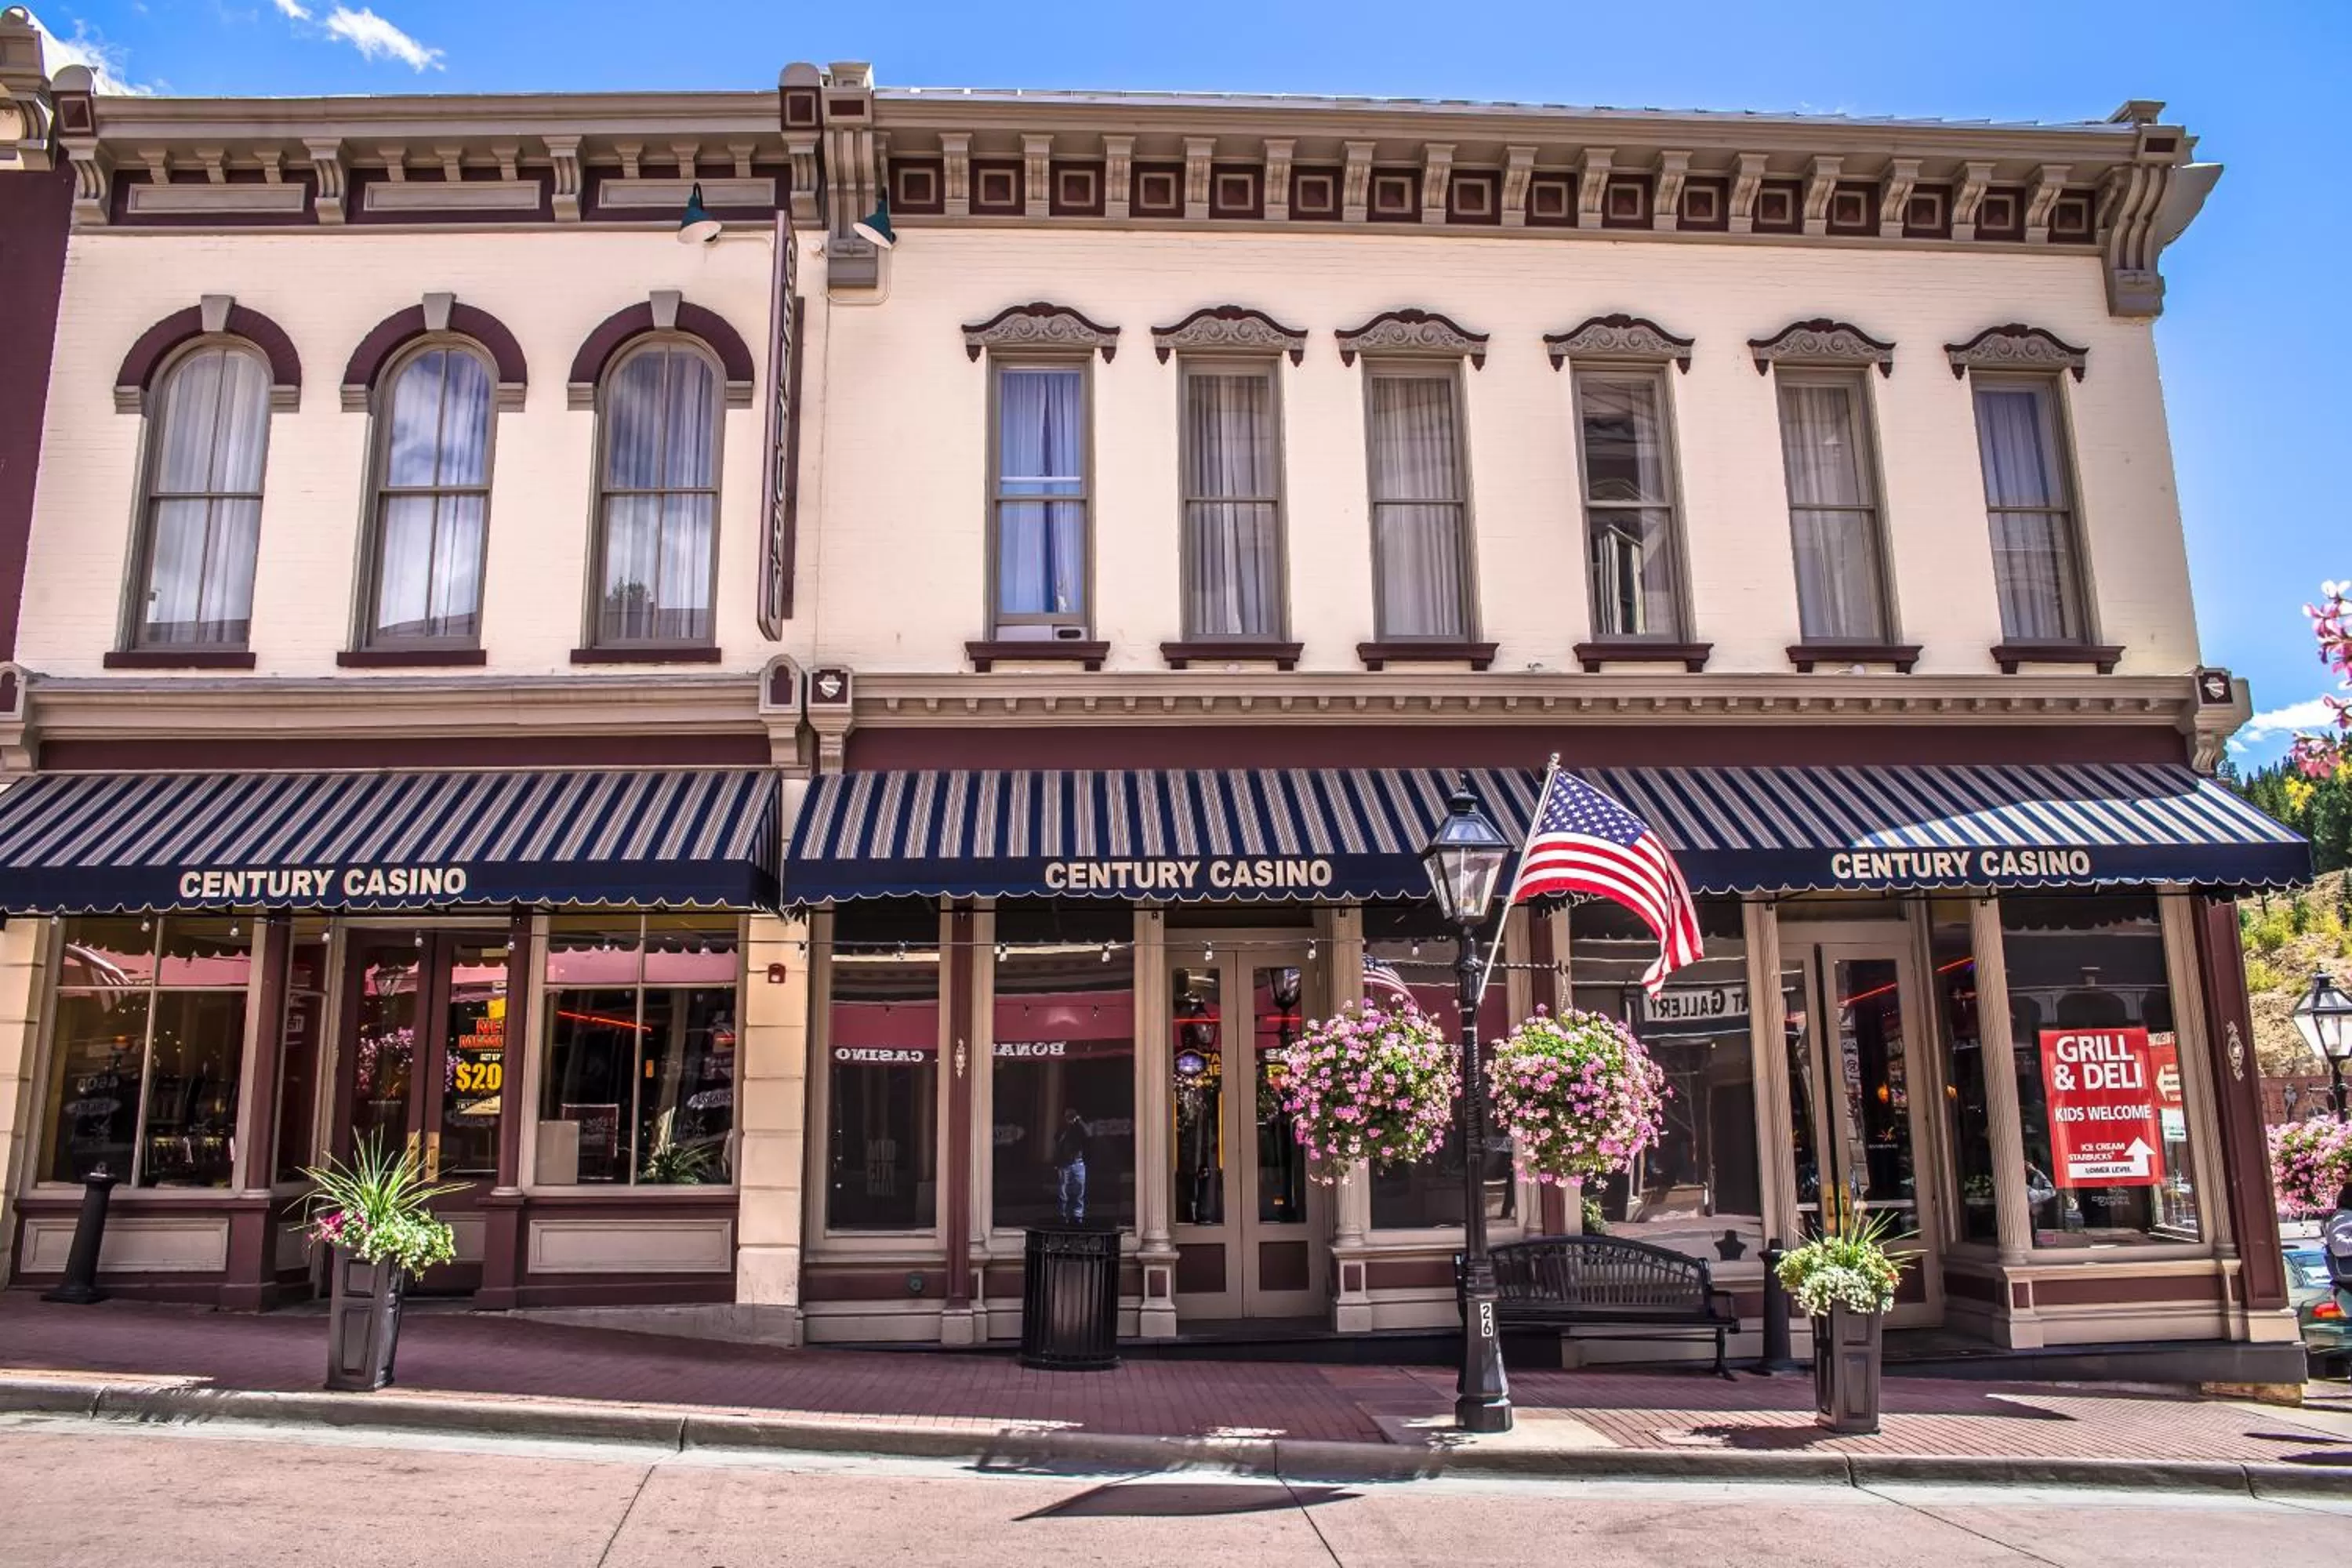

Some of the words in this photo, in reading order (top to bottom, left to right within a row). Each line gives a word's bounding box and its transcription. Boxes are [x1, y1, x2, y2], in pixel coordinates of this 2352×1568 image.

[771, 238, 796, 620] CENTURY
[1045, 862, 1200, 888] CENTURY
[1210, 859, 1332, 887] CASINO
[1831, 851, 1971, 879] CENTURY
[1980, 850, 2090, 877] CASINO
[179, 869, 335, 898] CENTURY
[343, 867, 466, 896] CASINO
[476, 1020, 504, 1035] NE
[2056, 1034, 2135, 1062] GRILL
[2053, 1063, 2076, 1091] &
[2082, 1062, 2143, 1091] DELI
[2054, 1105, 2085, 1122] KIDS
[2088, 1103, 2152, 1121] WELCOME
[2081, 1143, 2094, 1152] ICE
[2095, 1142, 2125, 1151] CREAM
[2085, 1166, 2111, 1174] LOWER
[2111, 1165, 2132, 1174] LEVEL
[1482, 1304, 1492, 1335] 26
